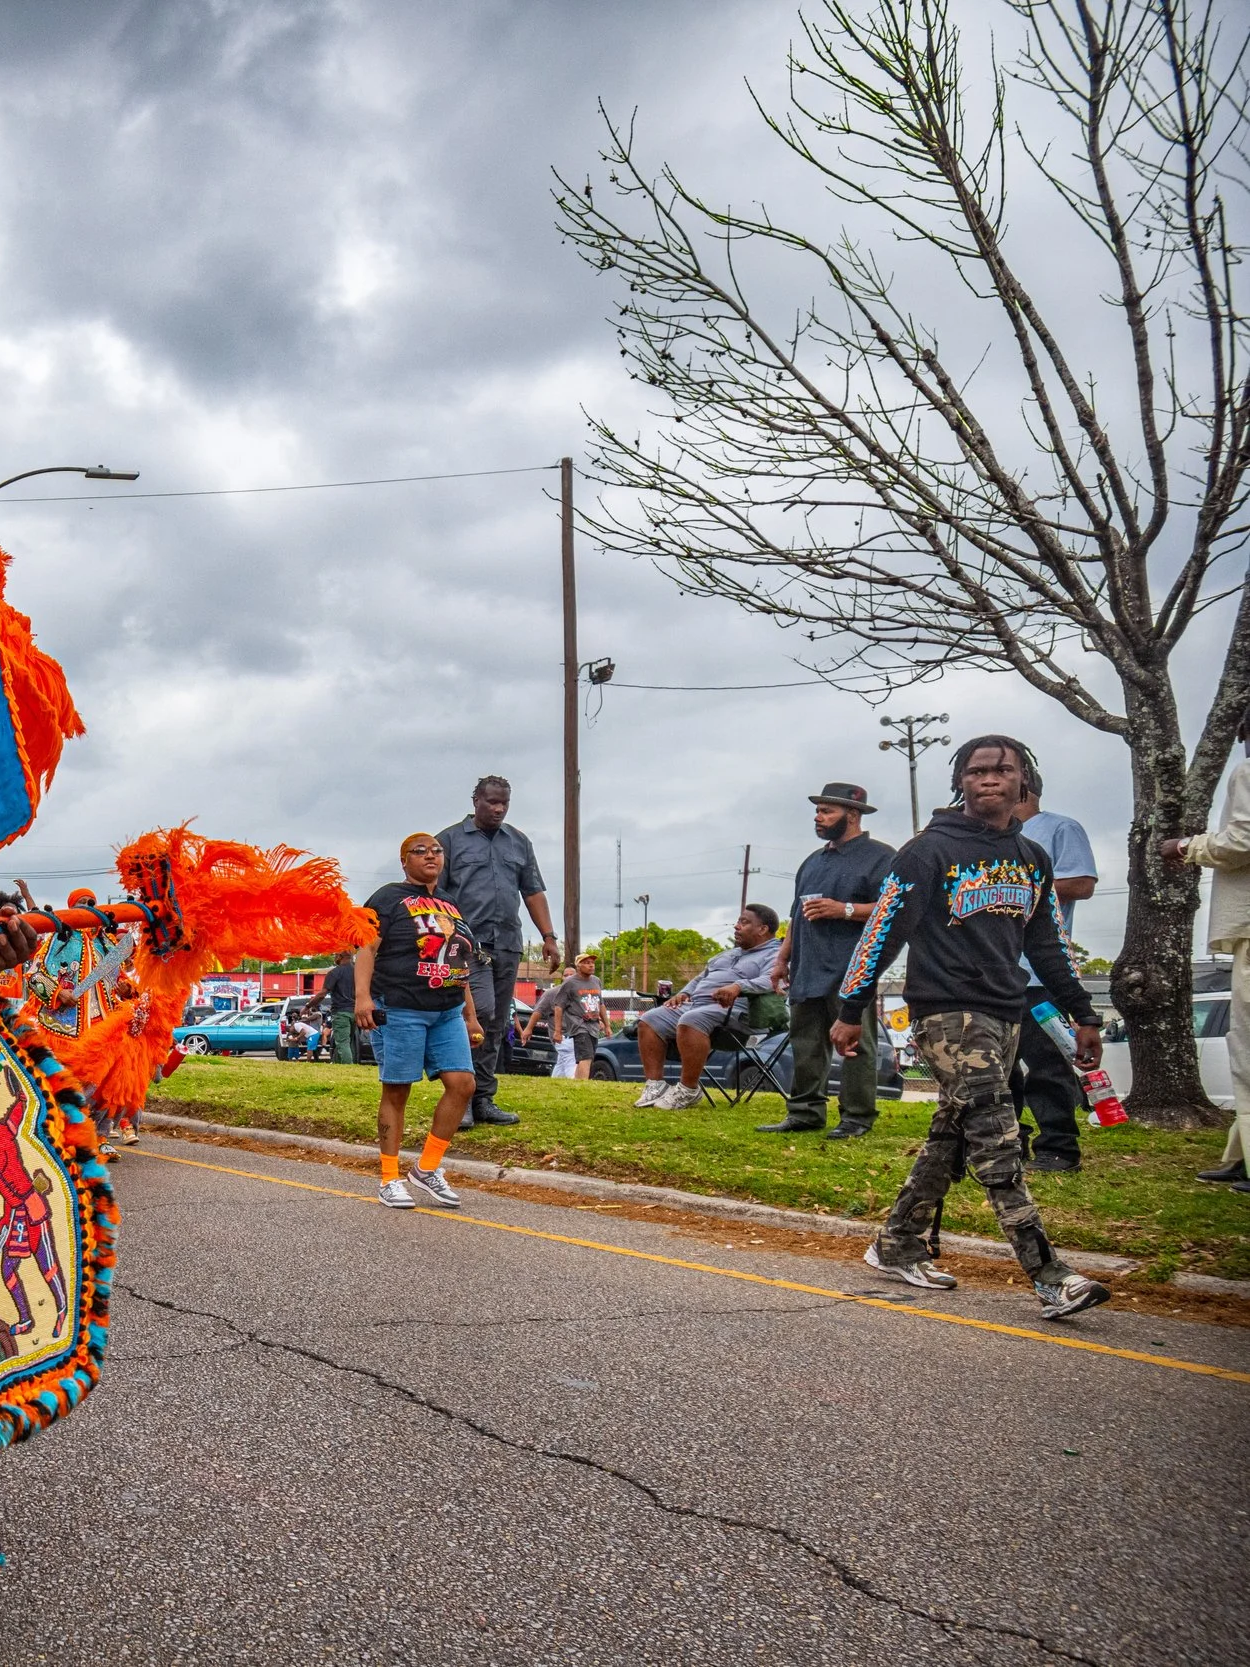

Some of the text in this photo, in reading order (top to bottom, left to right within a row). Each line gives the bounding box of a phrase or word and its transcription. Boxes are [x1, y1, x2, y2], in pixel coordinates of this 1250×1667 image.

[404, 897, 463, 920] BOLTO
[961, 888, 998, 915] KING
[414, 914, 443, 934] 14
[417, 962, 450, 978] EHS
